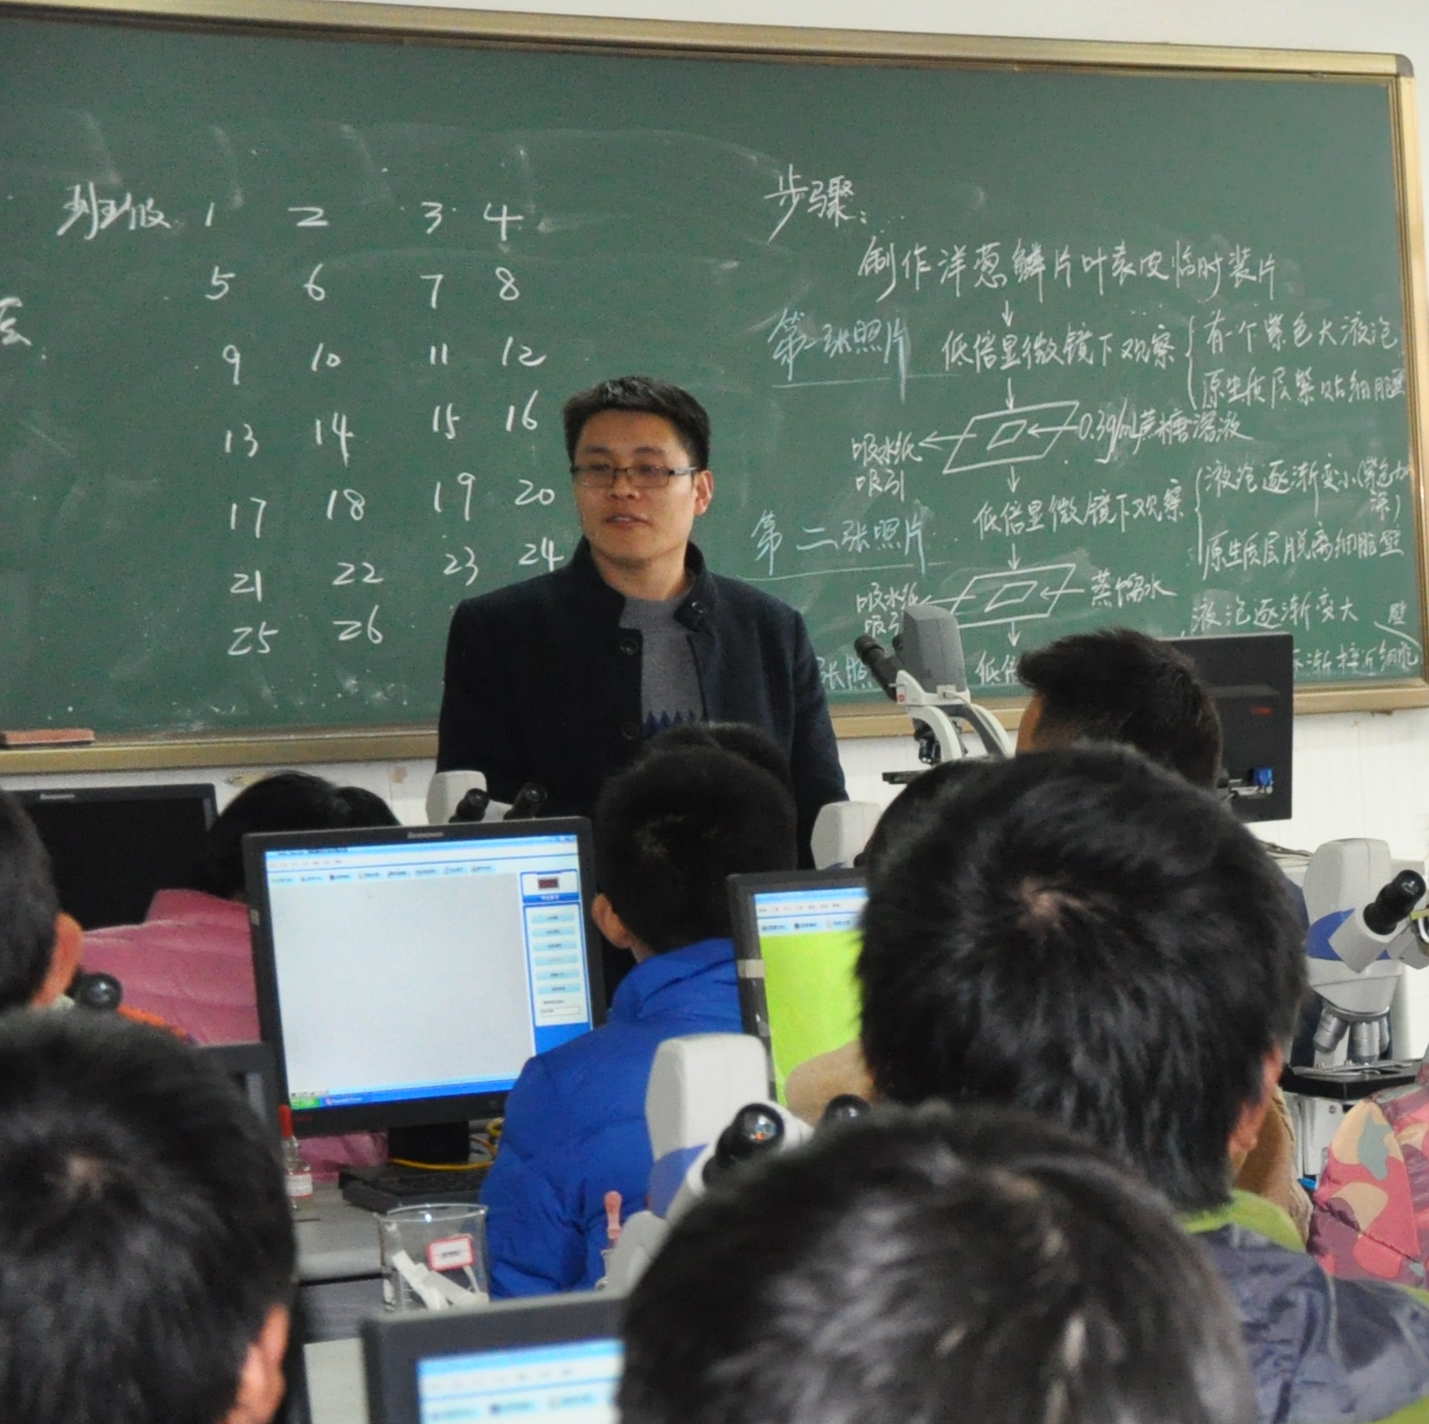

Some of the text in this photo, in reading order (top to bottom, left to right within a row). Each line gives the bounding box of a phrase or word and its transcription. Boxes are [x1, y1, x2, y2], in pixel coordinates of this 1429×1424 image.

[205, 202, 215, 227] 1
[288, 205, 328, 227] 2
[421, 202, 443, 234] 3
[483, 204, 523, 240] 4
[206, 263, 520, 308] 5 6 7 8
[223, 337, 546, 385] 9 10 11 12
[225, 391, 539, 466] 13 14 15 16
[229, 473, 555, 538] 17 18 19 20
[230, 538, 565, 602] 21 22 23 24
[227, 606, 383, 655] 25 26
